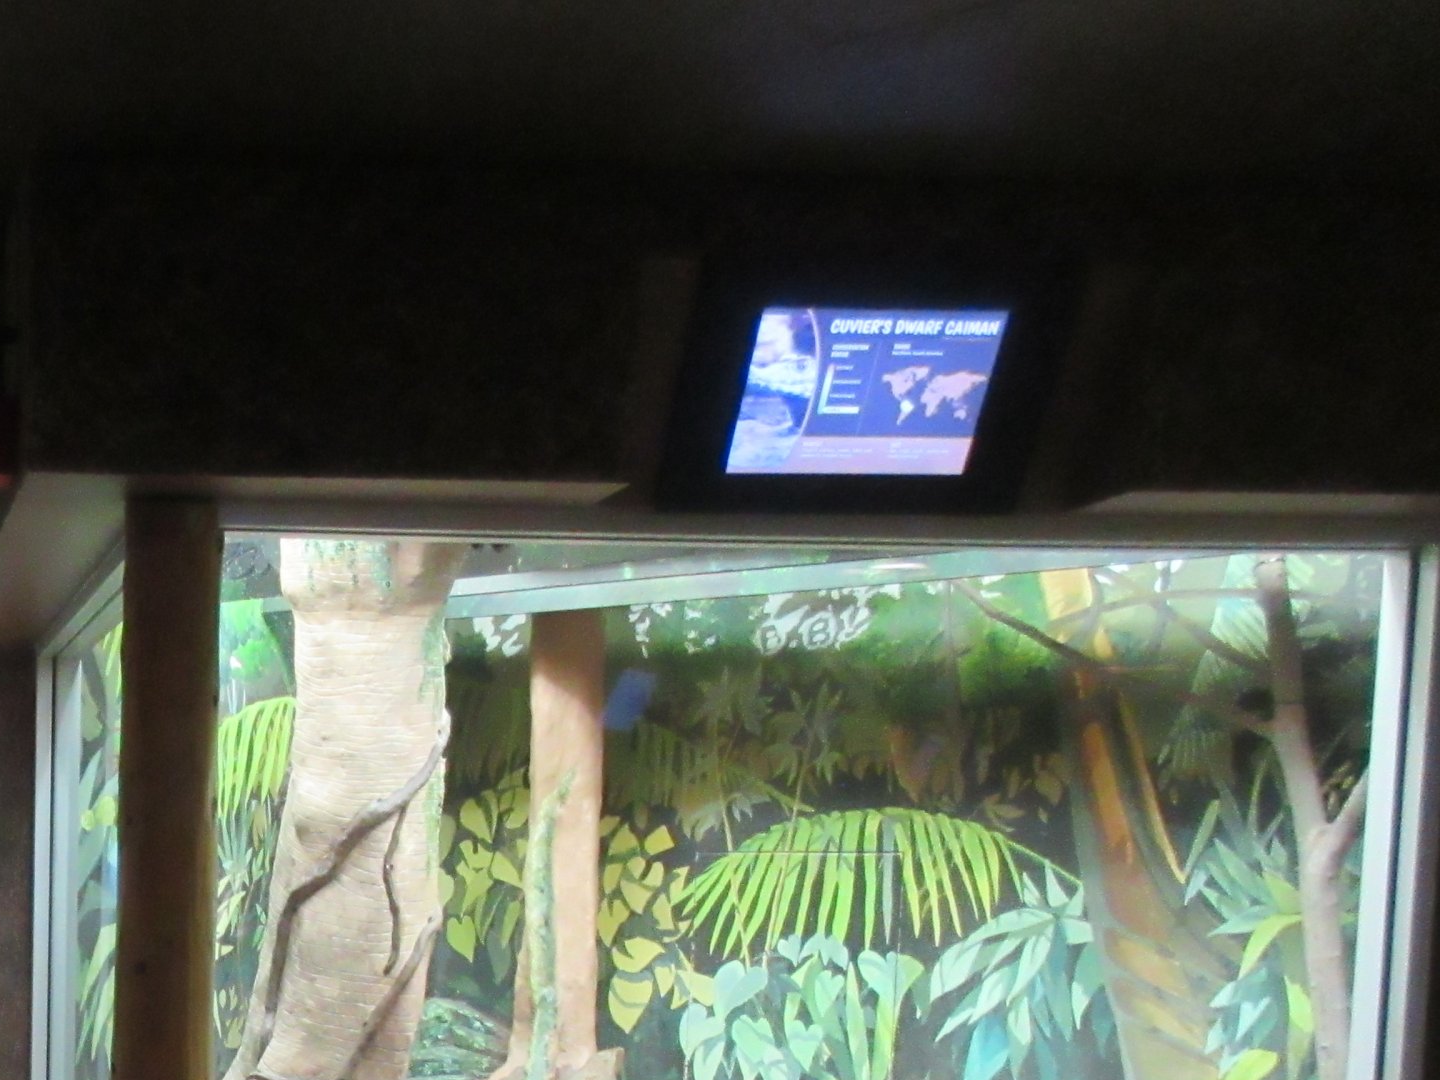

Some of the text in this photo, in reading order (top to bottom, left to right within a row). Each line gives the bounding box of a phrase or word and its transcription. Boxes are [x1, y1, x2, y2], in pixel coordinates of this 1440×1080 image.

[830, 318, 999, 336] CUVIER'S DWARF CAIMAN
